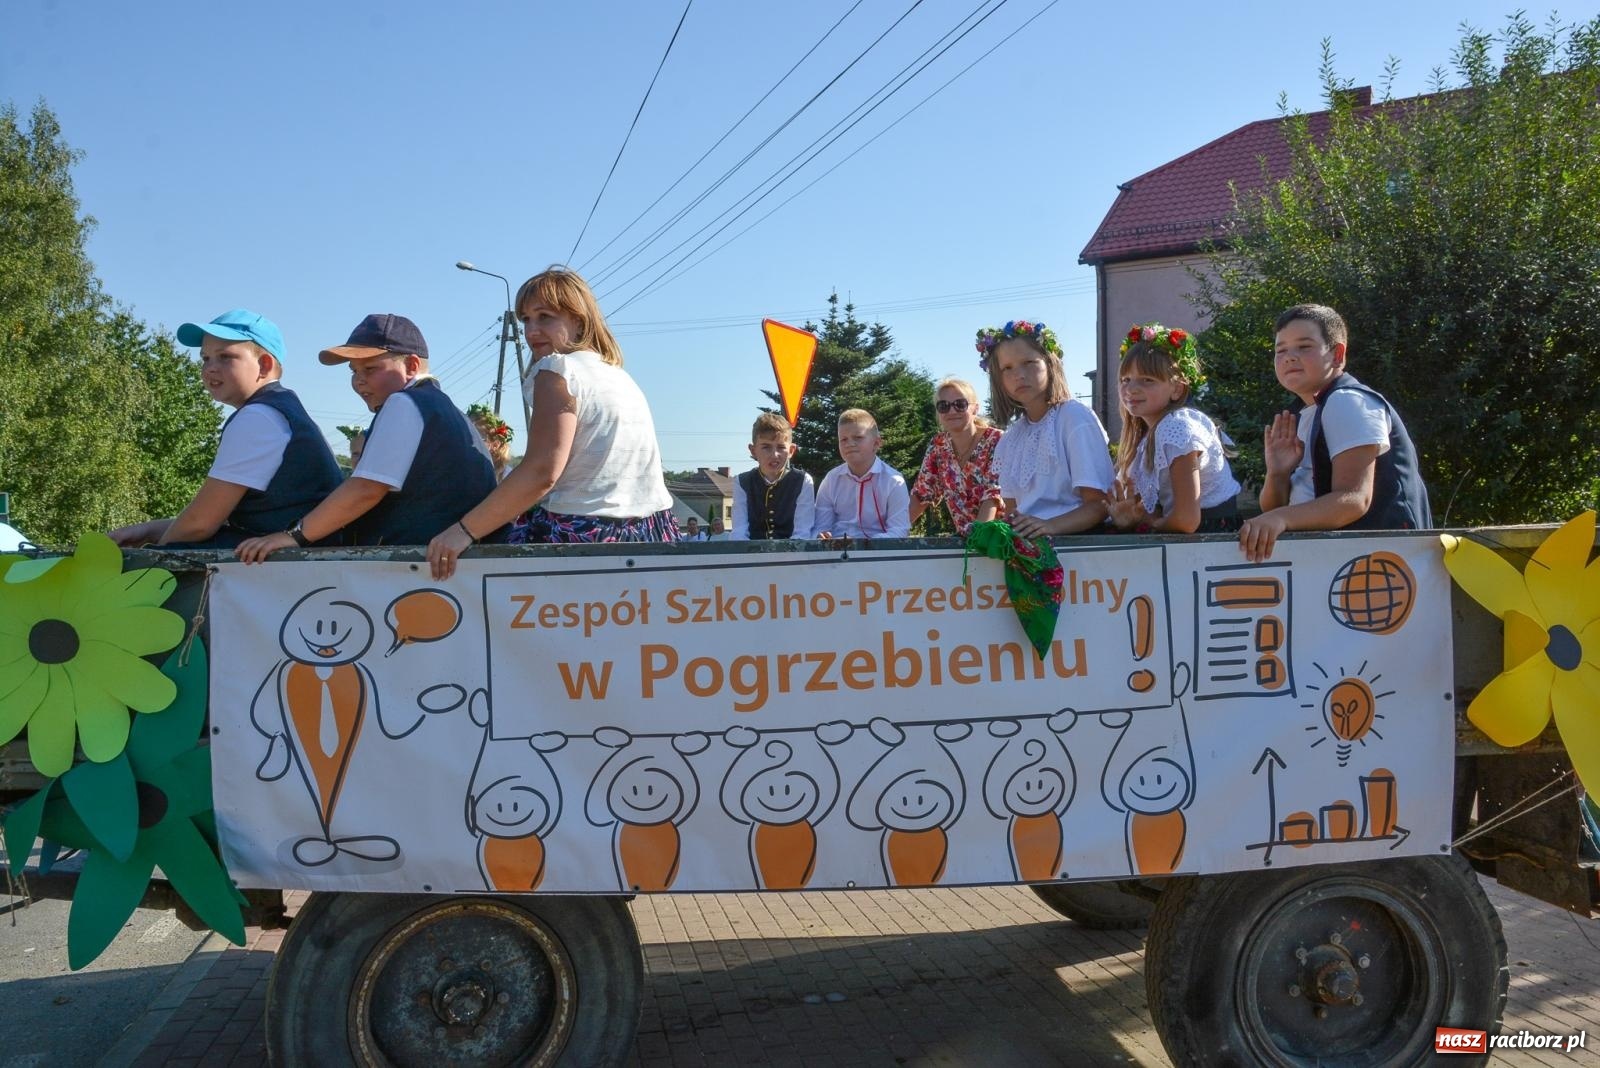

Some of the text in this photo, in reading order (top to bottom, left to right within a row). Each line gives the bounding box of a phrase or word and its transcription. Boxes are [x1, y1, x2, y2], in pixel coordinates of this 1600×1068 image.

[510, 570, 1128, 638] Zespół Szkolno-Przedszlny
[557, 661, 613, 700] w
